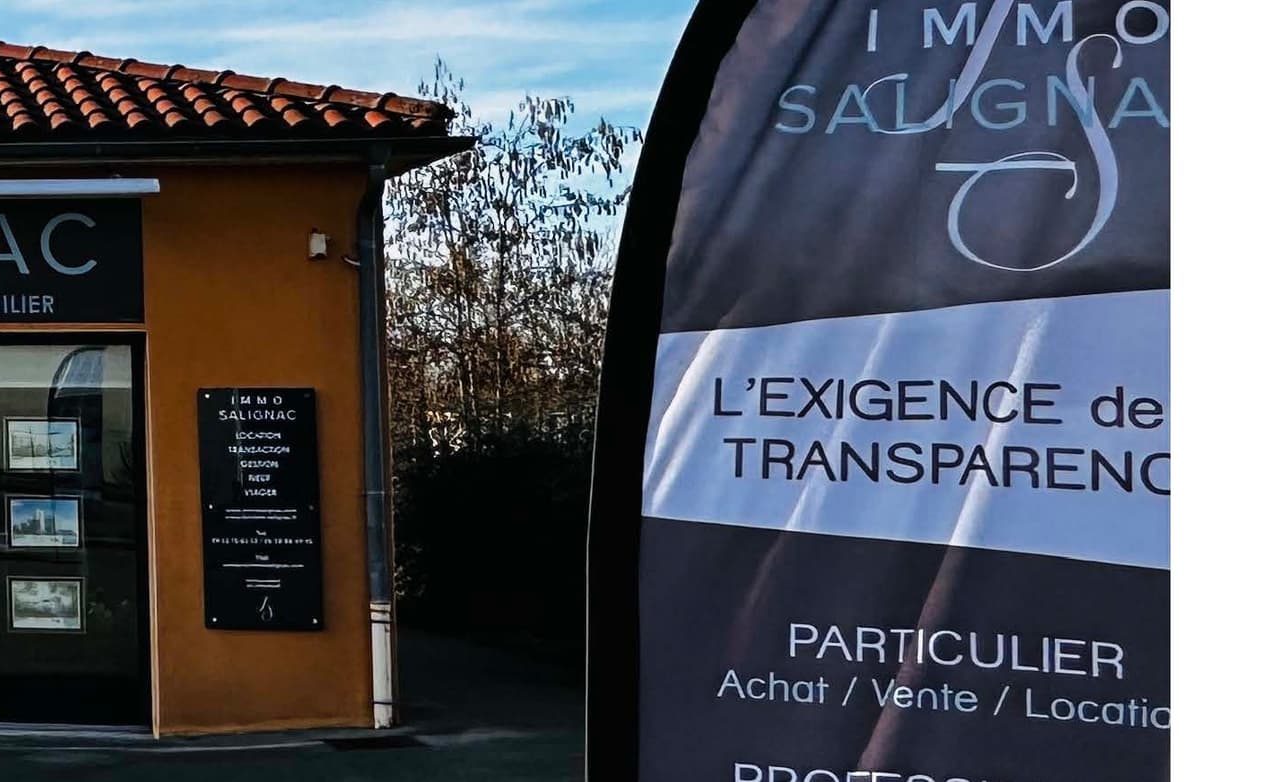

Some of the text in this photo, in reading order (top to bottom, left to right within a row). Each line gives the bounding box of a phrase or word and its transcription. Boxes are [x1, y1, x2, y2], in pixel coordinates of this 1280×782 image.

[867, 0, 1170, 52] IMMO
[775, 75, 1170, 134] SALIGNA
[219, 410, 297, 421] SALIGNAC
[713, 377, 1165, 429] L'EXIGENCE de
[788, 623, 1125, 679] PARTICULIER
[717, 669, 830, 705] Achat
[871, 679, 979, 712] Vente
